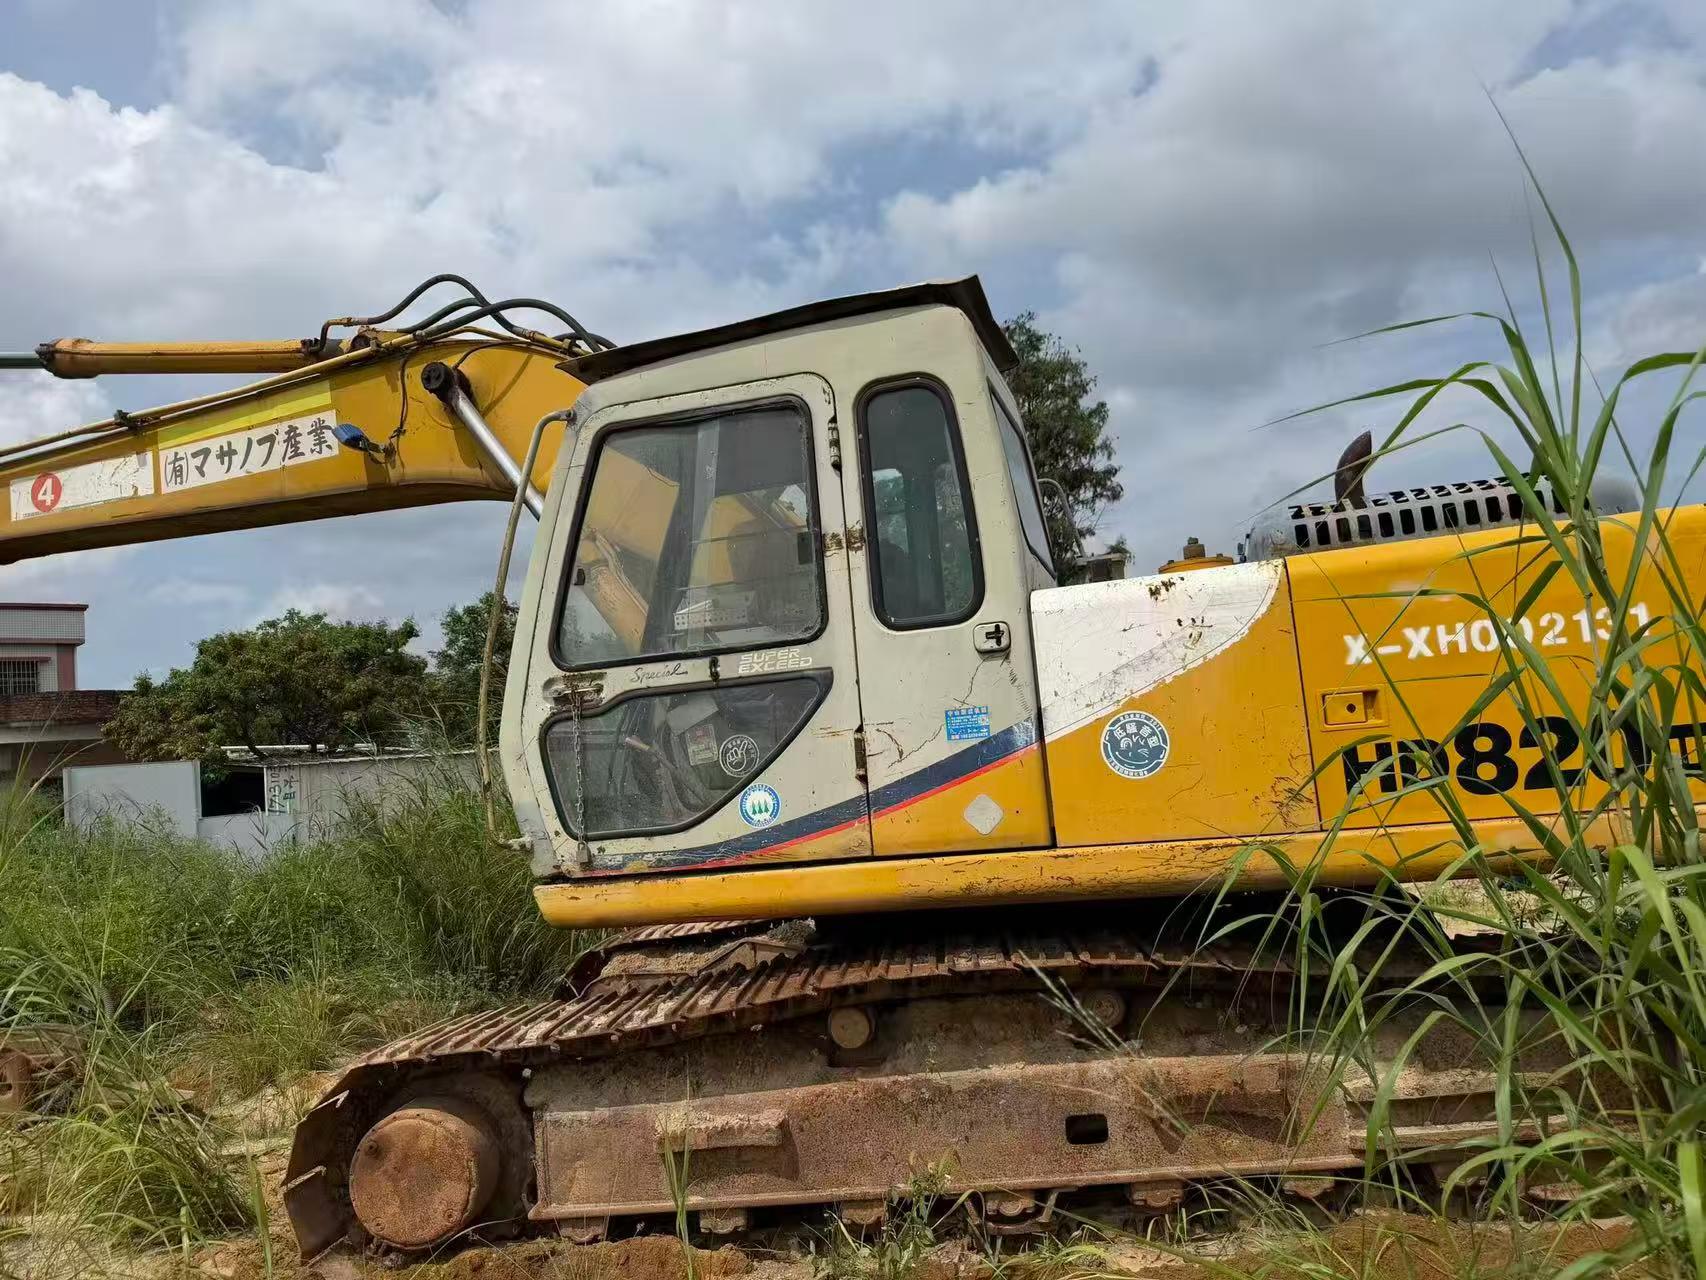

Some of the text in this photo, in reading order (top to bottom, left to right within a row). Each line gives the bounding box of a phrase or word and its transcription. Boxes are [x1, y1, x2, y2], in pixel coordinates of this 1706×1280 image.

[37, 477, 55, 506] 4
[738, 656, 812, 674] EXCEED
[739, 648, 801, 664] SUPER
[630, 663, 688, 684] Special
